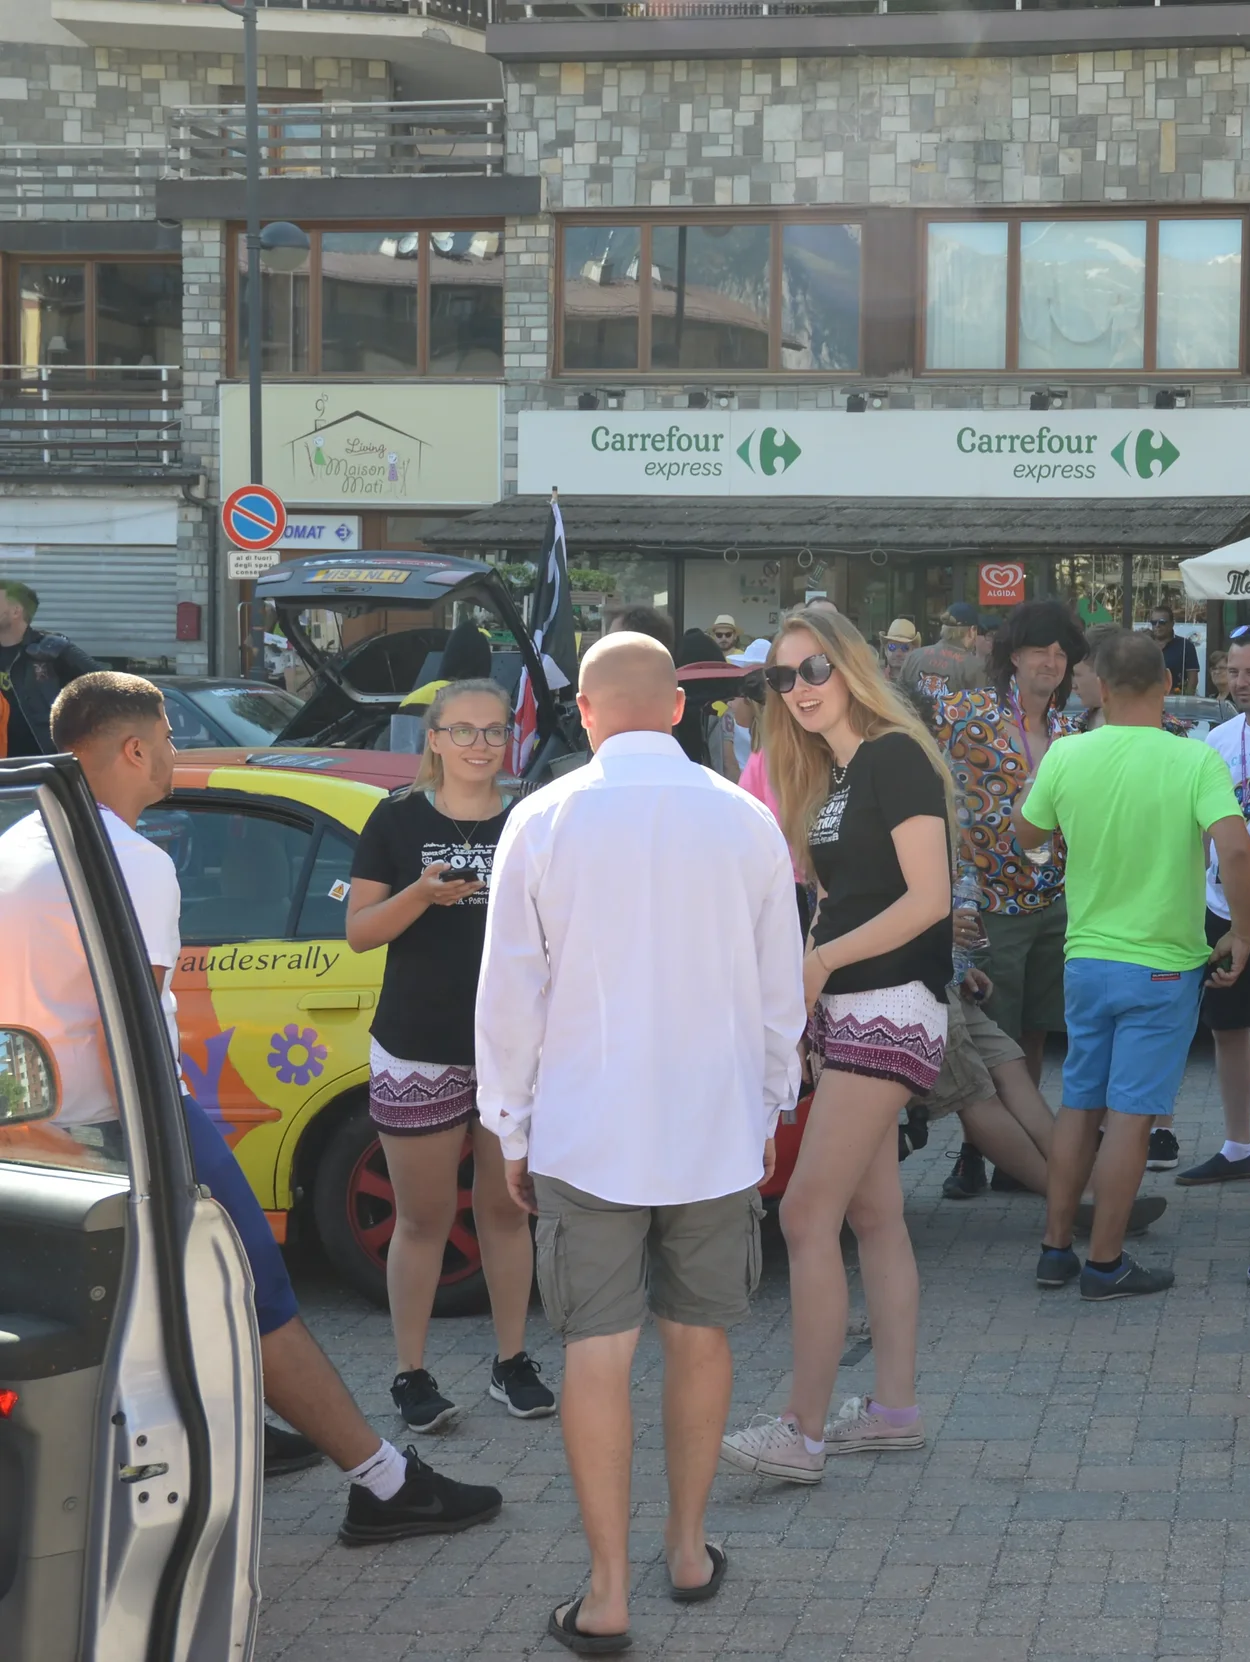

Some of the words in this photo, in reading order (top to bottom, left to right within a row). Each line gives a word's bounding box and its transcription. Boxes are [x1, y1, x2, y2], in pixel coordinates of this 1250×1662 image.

[345, 438, 387, 459] Living
[591, 425, 724, 452] Carrefour
[956, 426, 1098, 454] Carrefour
[326, 456, 386, 476] Maison
[644, 460, 723, 481] express
[1012, 462, 1097, 483] express
[284, 525, 326, 539] OMAT
